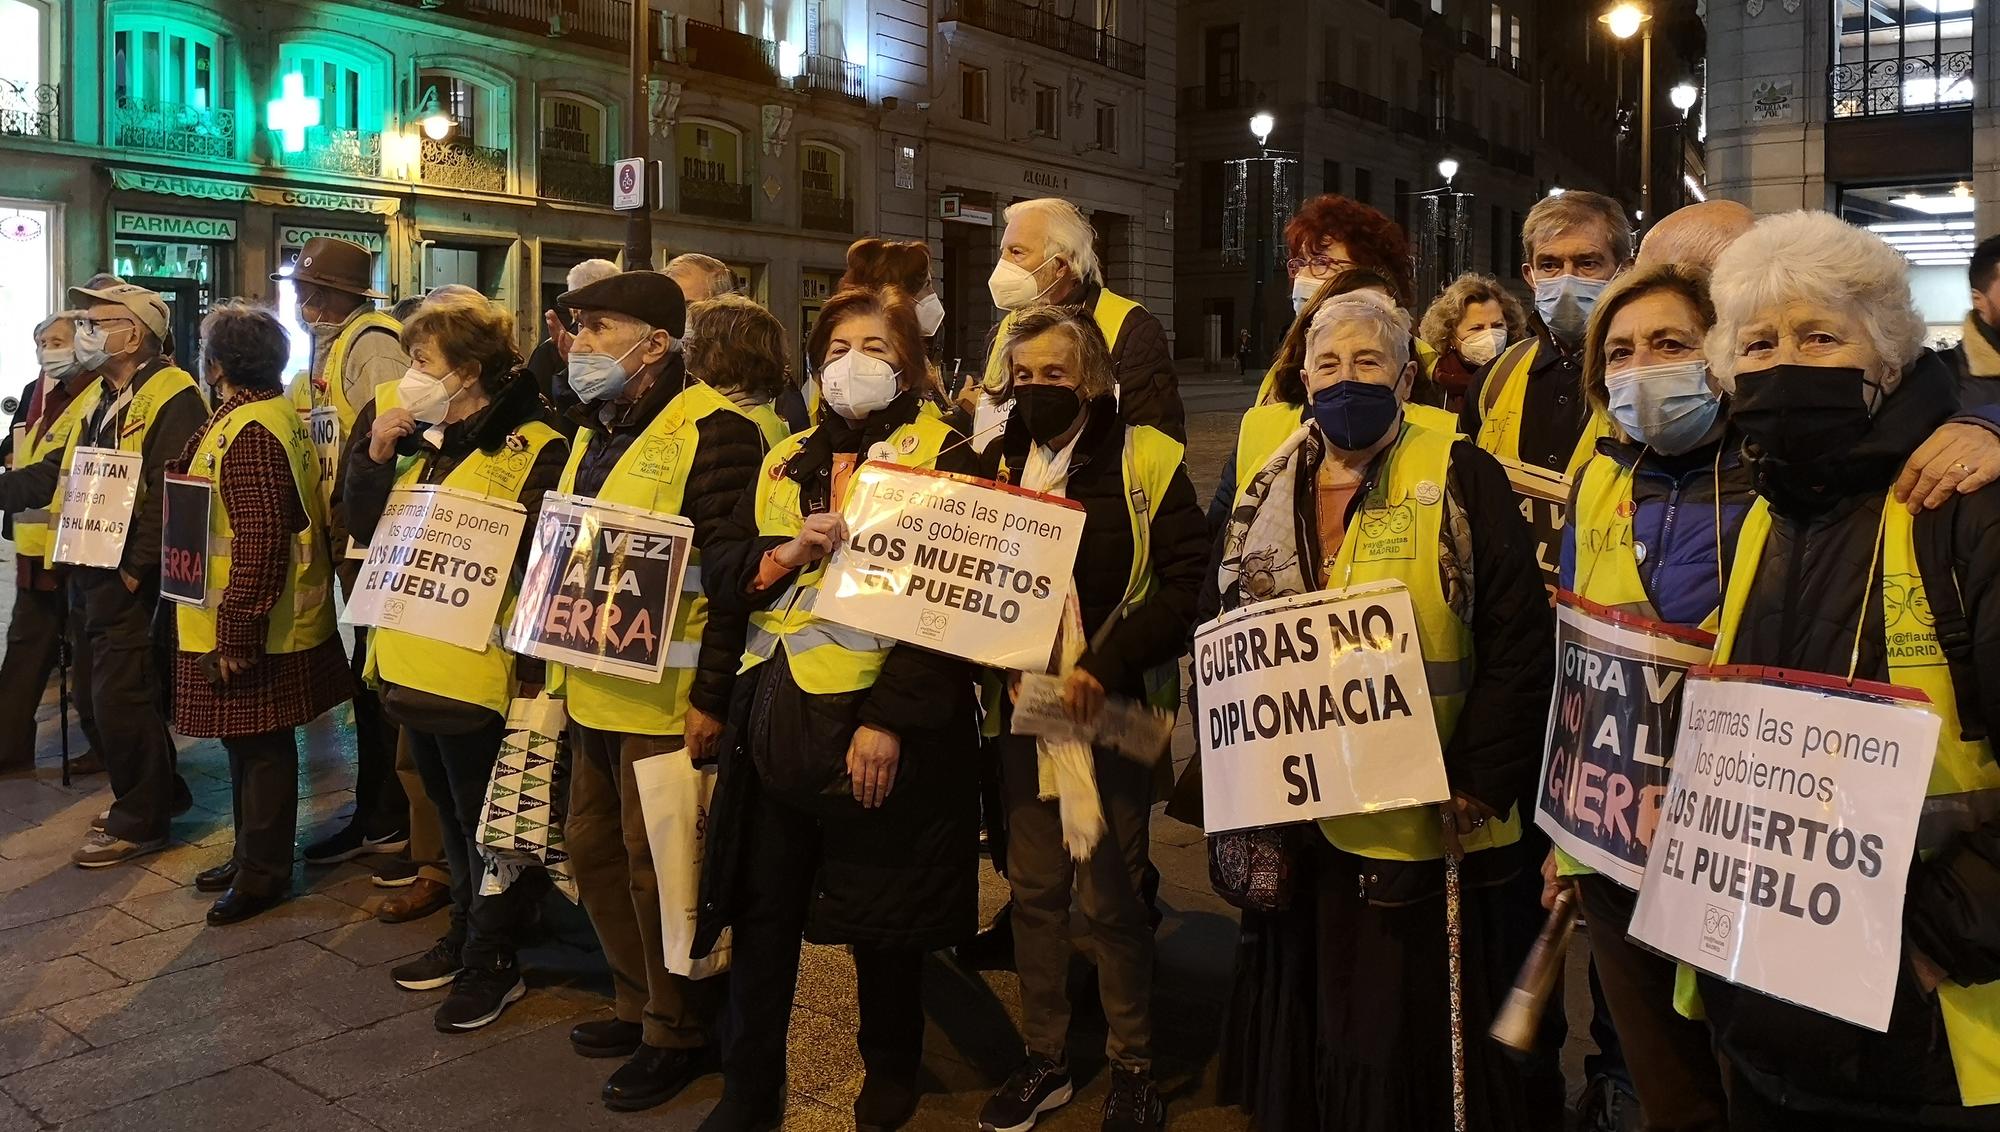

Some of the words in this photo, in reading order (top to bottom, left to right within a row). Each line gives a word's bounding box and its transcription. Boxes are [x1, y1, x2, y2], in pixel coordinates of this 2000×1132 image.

[554, 102, 582, 131] LOCAL
[140, 177, 255, 199] FARMACIA
[1063, 177, 1068, 190] 1
[121, 215, 231, 236] FARMACIA
[462, 212, 472, 223] 14
[318, 420, 337, 447] NO,
[83, 461, 130, 481] MATAN,
[71, 518, 124, 534] HUMANOS
[382, 503, 397, 516] Las
[397, 504, 428, 517] armas
[431, 503, 453, 522] las
[456, 513, 510, 536] ponen
[872, 481, 905, 503] Las
[909, 487, 966, 516] armas
[971, 500, 998, 524] las
[1002, 511, 1062, 540] ponen
[389, 521, 401, 536] los
[401, 524, 472, 550] gobiernos
[603, 530, 672, 561] VEZ
[896, 509, 923, 533] los
[928, 517, 1020, 557] gobiernos
[1369, 545, 1401, 556] MADRID
[368, 545, 389, 565] LOS
[388, 545, 498, 587] MUERTOS
[564, 562, 585, 588] A
[594, 566, 641, 597] LA
[850, 532, 907, 561] LOS
[913, 544, 1051, 600] MUERTOS
[366, 570, 379, 590] EL
[379, 570, 470, 607] PUEBLO
[864, 564, 895, 593] EL
[905, 574, 1021, 624] PUEBLO
[1200, 617, 1319, 686] GUERRAS
[1328, 604, 1408, 655] NO,
[1887, 645, 1938, 658] MADRID
[1565, 647, 1627, 697] OTRA
[1210, 674, 1412, 750] DIPLOMACIA
[1592, 714, 1621, 756] A
[1632, 723, 1674, 769] L
[1687, 701, 1705, 731] Las
[1706, 706, 1750, 738] armas
[1755, 708, 1794, 746] las
[1801, 724, 1900, 768] ponen
[1282, 753, 1321, 806] SI
[1694, 743, 1714, 775] los
[1713, 750, 1834, 803] gobiernos
[1666, 785, 1698, 828] LOS
[1698, 794, 1884, 879] MUERTOS
[1662, 838, 1686, 881] EL
[1691, 846, 1842, 926] PUEBLO
